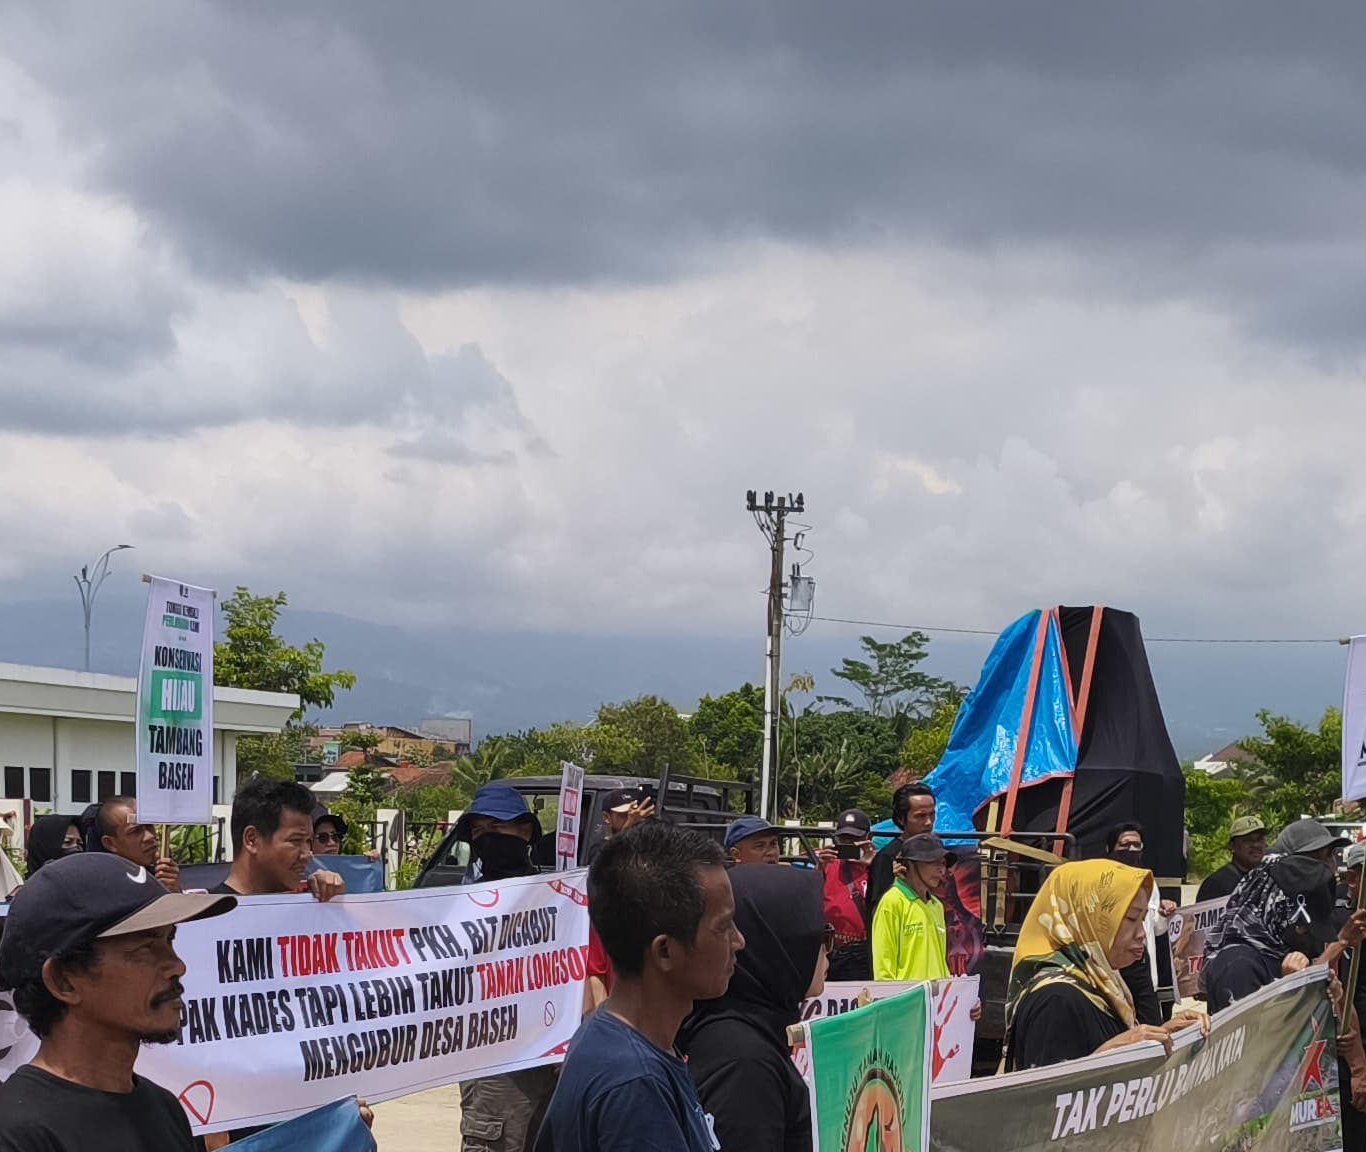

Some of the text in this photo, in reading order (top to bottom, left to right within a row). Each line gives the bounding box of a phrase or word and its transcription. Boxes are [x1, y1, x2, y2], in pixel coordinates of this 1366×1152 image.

[154, 645, 202, 672] KONSERVASI
[161, 678, 195, 713] HIJAU
[148, 724, 203, 757] TAMBANG
[158, 761, 194, 790] BASEH
[216, 937, 274, 984] KAMI
[277, 932, 340, 977] TIDAK
[342, 929, 412, 971] TAKUT
[409, 924, 468, 961] PKH,
[223, 989, 295, 1039] KADES
[295, 983, 349, 1028] TAPI
[348, 976, 416, 1022] LEBIH
[415, 966, 474, 1011] TAKUT
[477, 957, 524, 1000] TANAH
[300, 1004, 518, 1082] MENGUBUR DESA BASEH
[1051, 1085, 1107, 1141] TAK
[1102, 1069, 1175, 1127] PERLU
